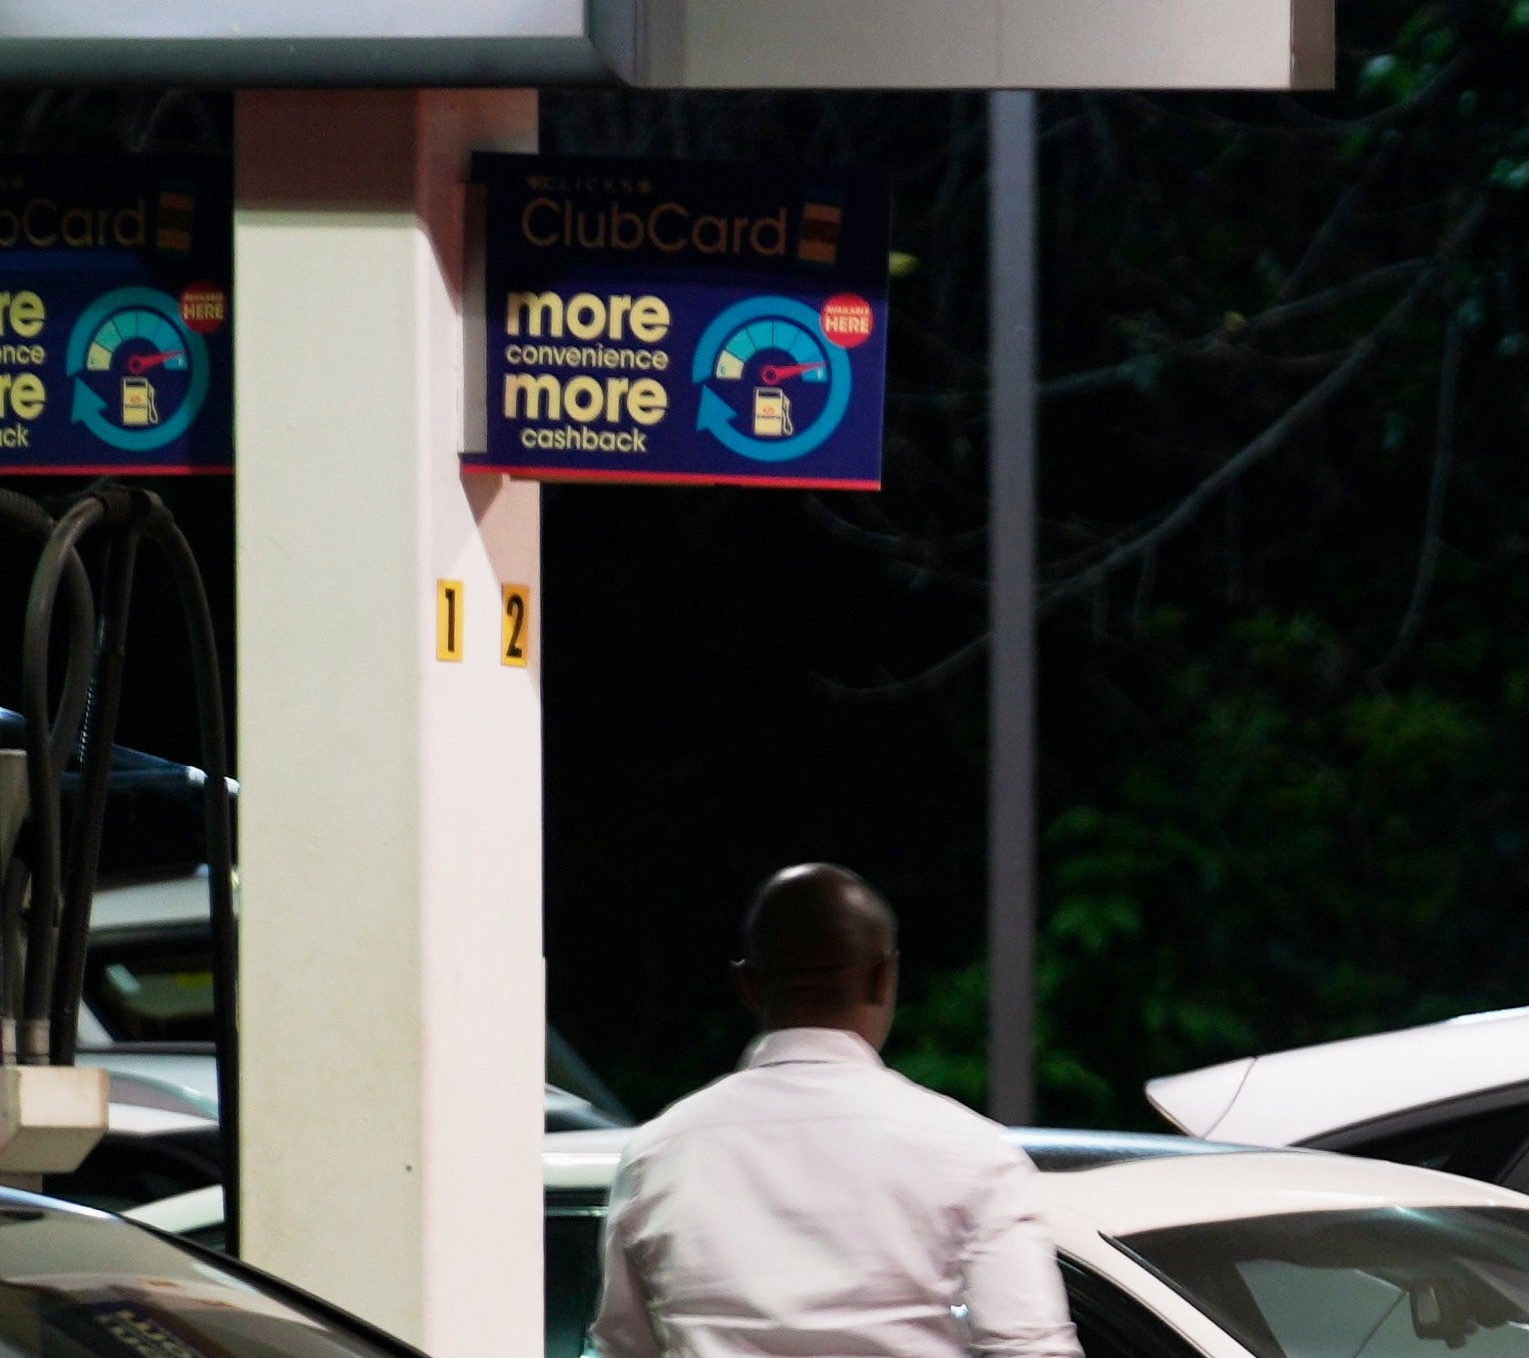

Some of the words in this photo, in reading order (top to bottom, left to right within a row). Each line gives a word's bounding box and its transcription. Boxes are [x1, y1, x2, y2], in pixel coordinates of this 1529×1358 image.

[521, 197, 787, 257] ClubCard
[507, 291, 671, 343] more
[825, 316, 870, 335] HERE
[506, 342, 669, 370] convenience
[504, 372, 668, 426] more
[521, 426, 646, 453] cashback
[443, 588, 455, 654] 1
[505, 591, 525, 658] 2
